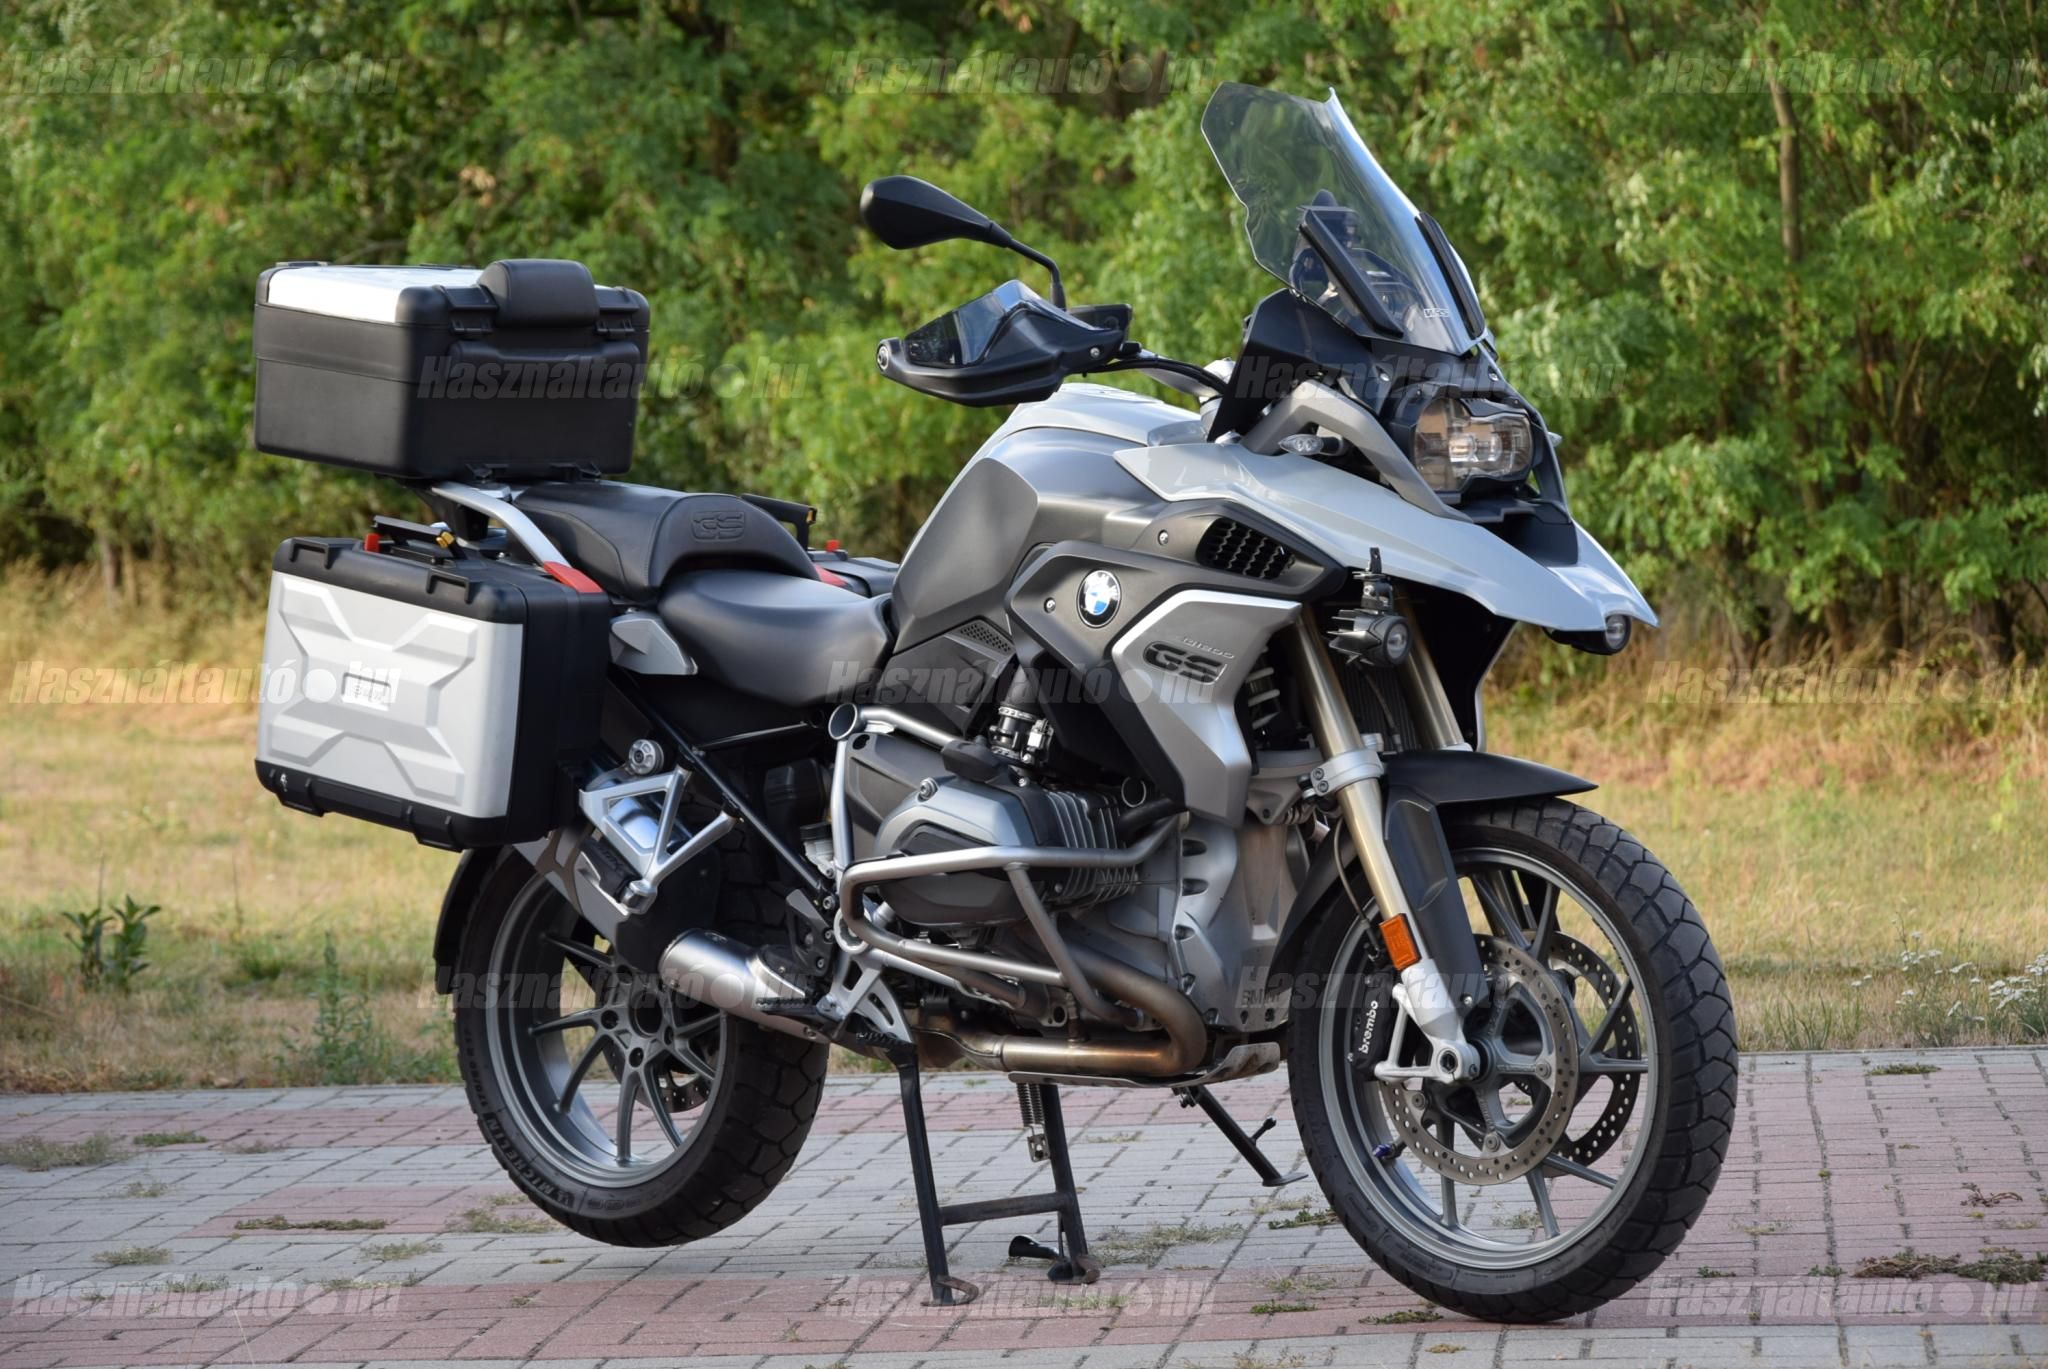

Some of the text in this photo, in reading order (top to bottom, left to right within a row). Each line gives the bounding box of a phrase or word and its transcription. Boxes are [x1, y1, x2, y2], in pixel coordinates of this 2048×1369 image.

[691, 511, 745, 542] GS
[1143, 641, 1226, 685] GS
[1358, 1000, 1379, 1054] brembo
[485, 1115, 557, 1199] MICHELIN
